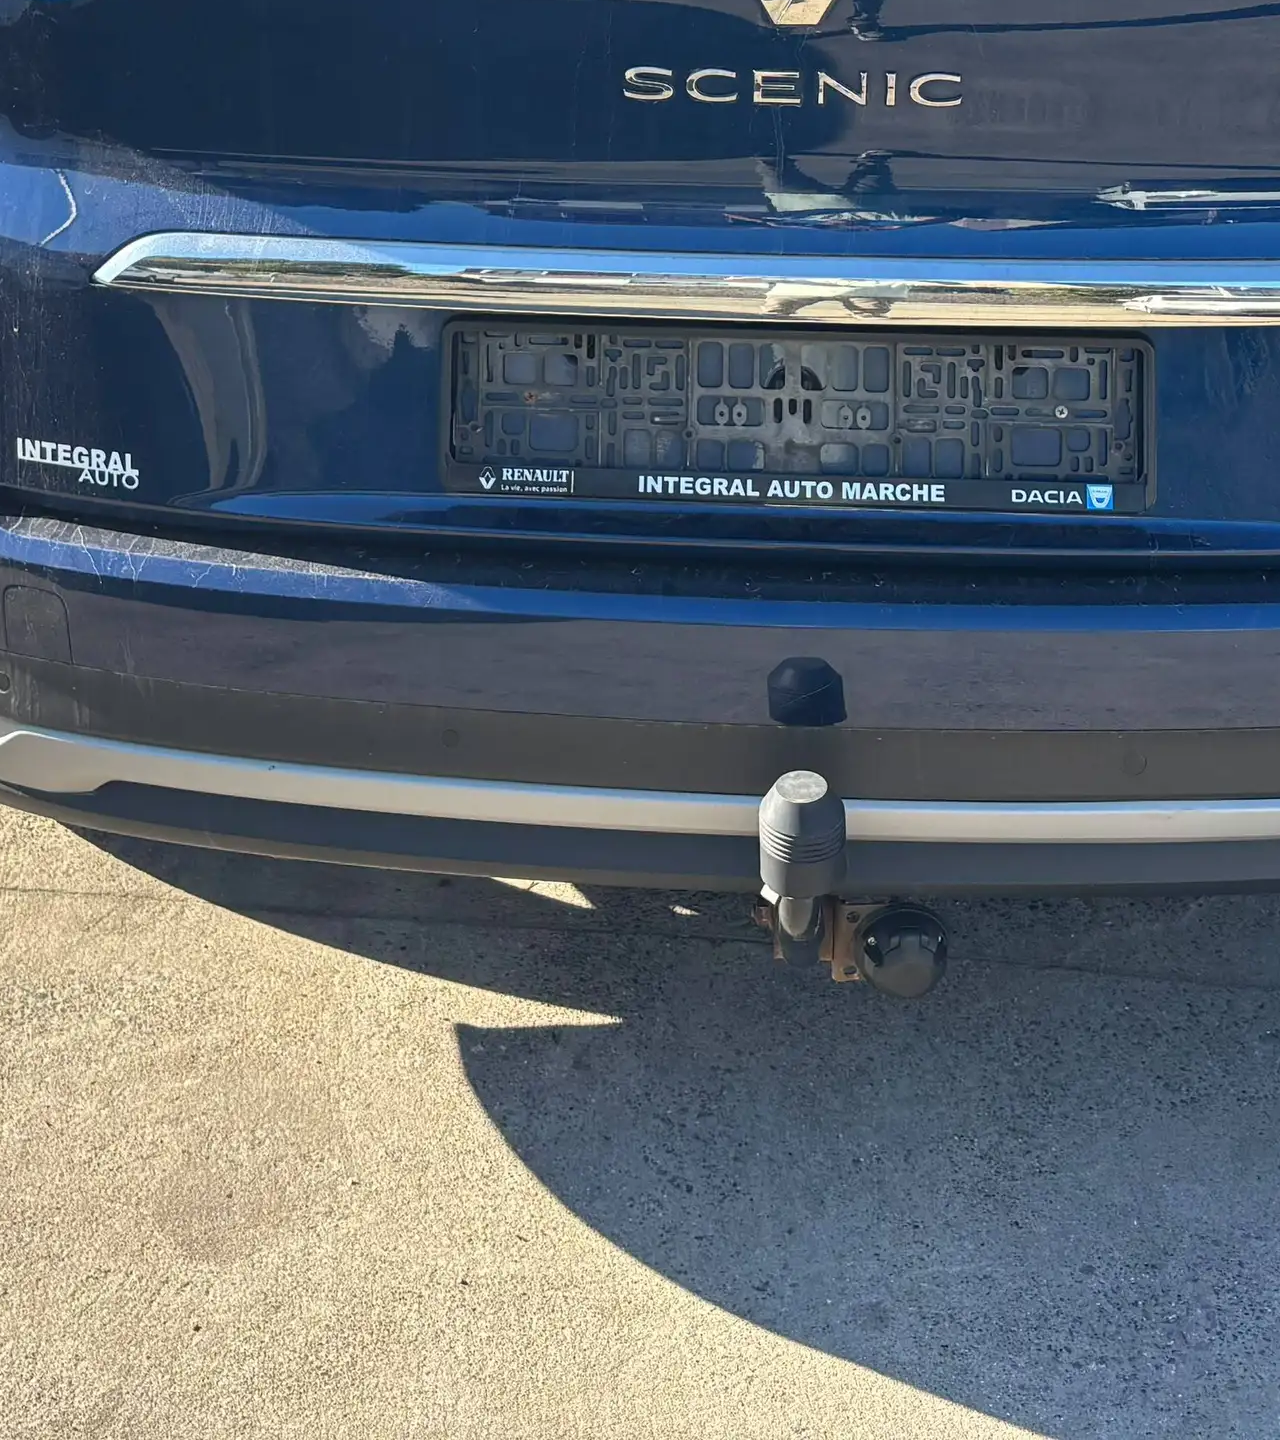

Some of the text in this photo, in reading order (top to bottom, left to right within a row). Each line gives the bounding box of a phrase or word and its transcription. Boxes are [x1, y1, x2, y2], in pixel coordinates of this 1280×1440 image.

[623, 66, 964, 108] SCENIC
[17, 437, 139, 476] INTEGRAL
[78, 467, 139, 490] AUTO
[502, 467, 570, 483] RENAULT
[638, 475, 946, 503] INTEGRAL AUTO MARCHE
[1011, 489, 1083, 505] DACIA
